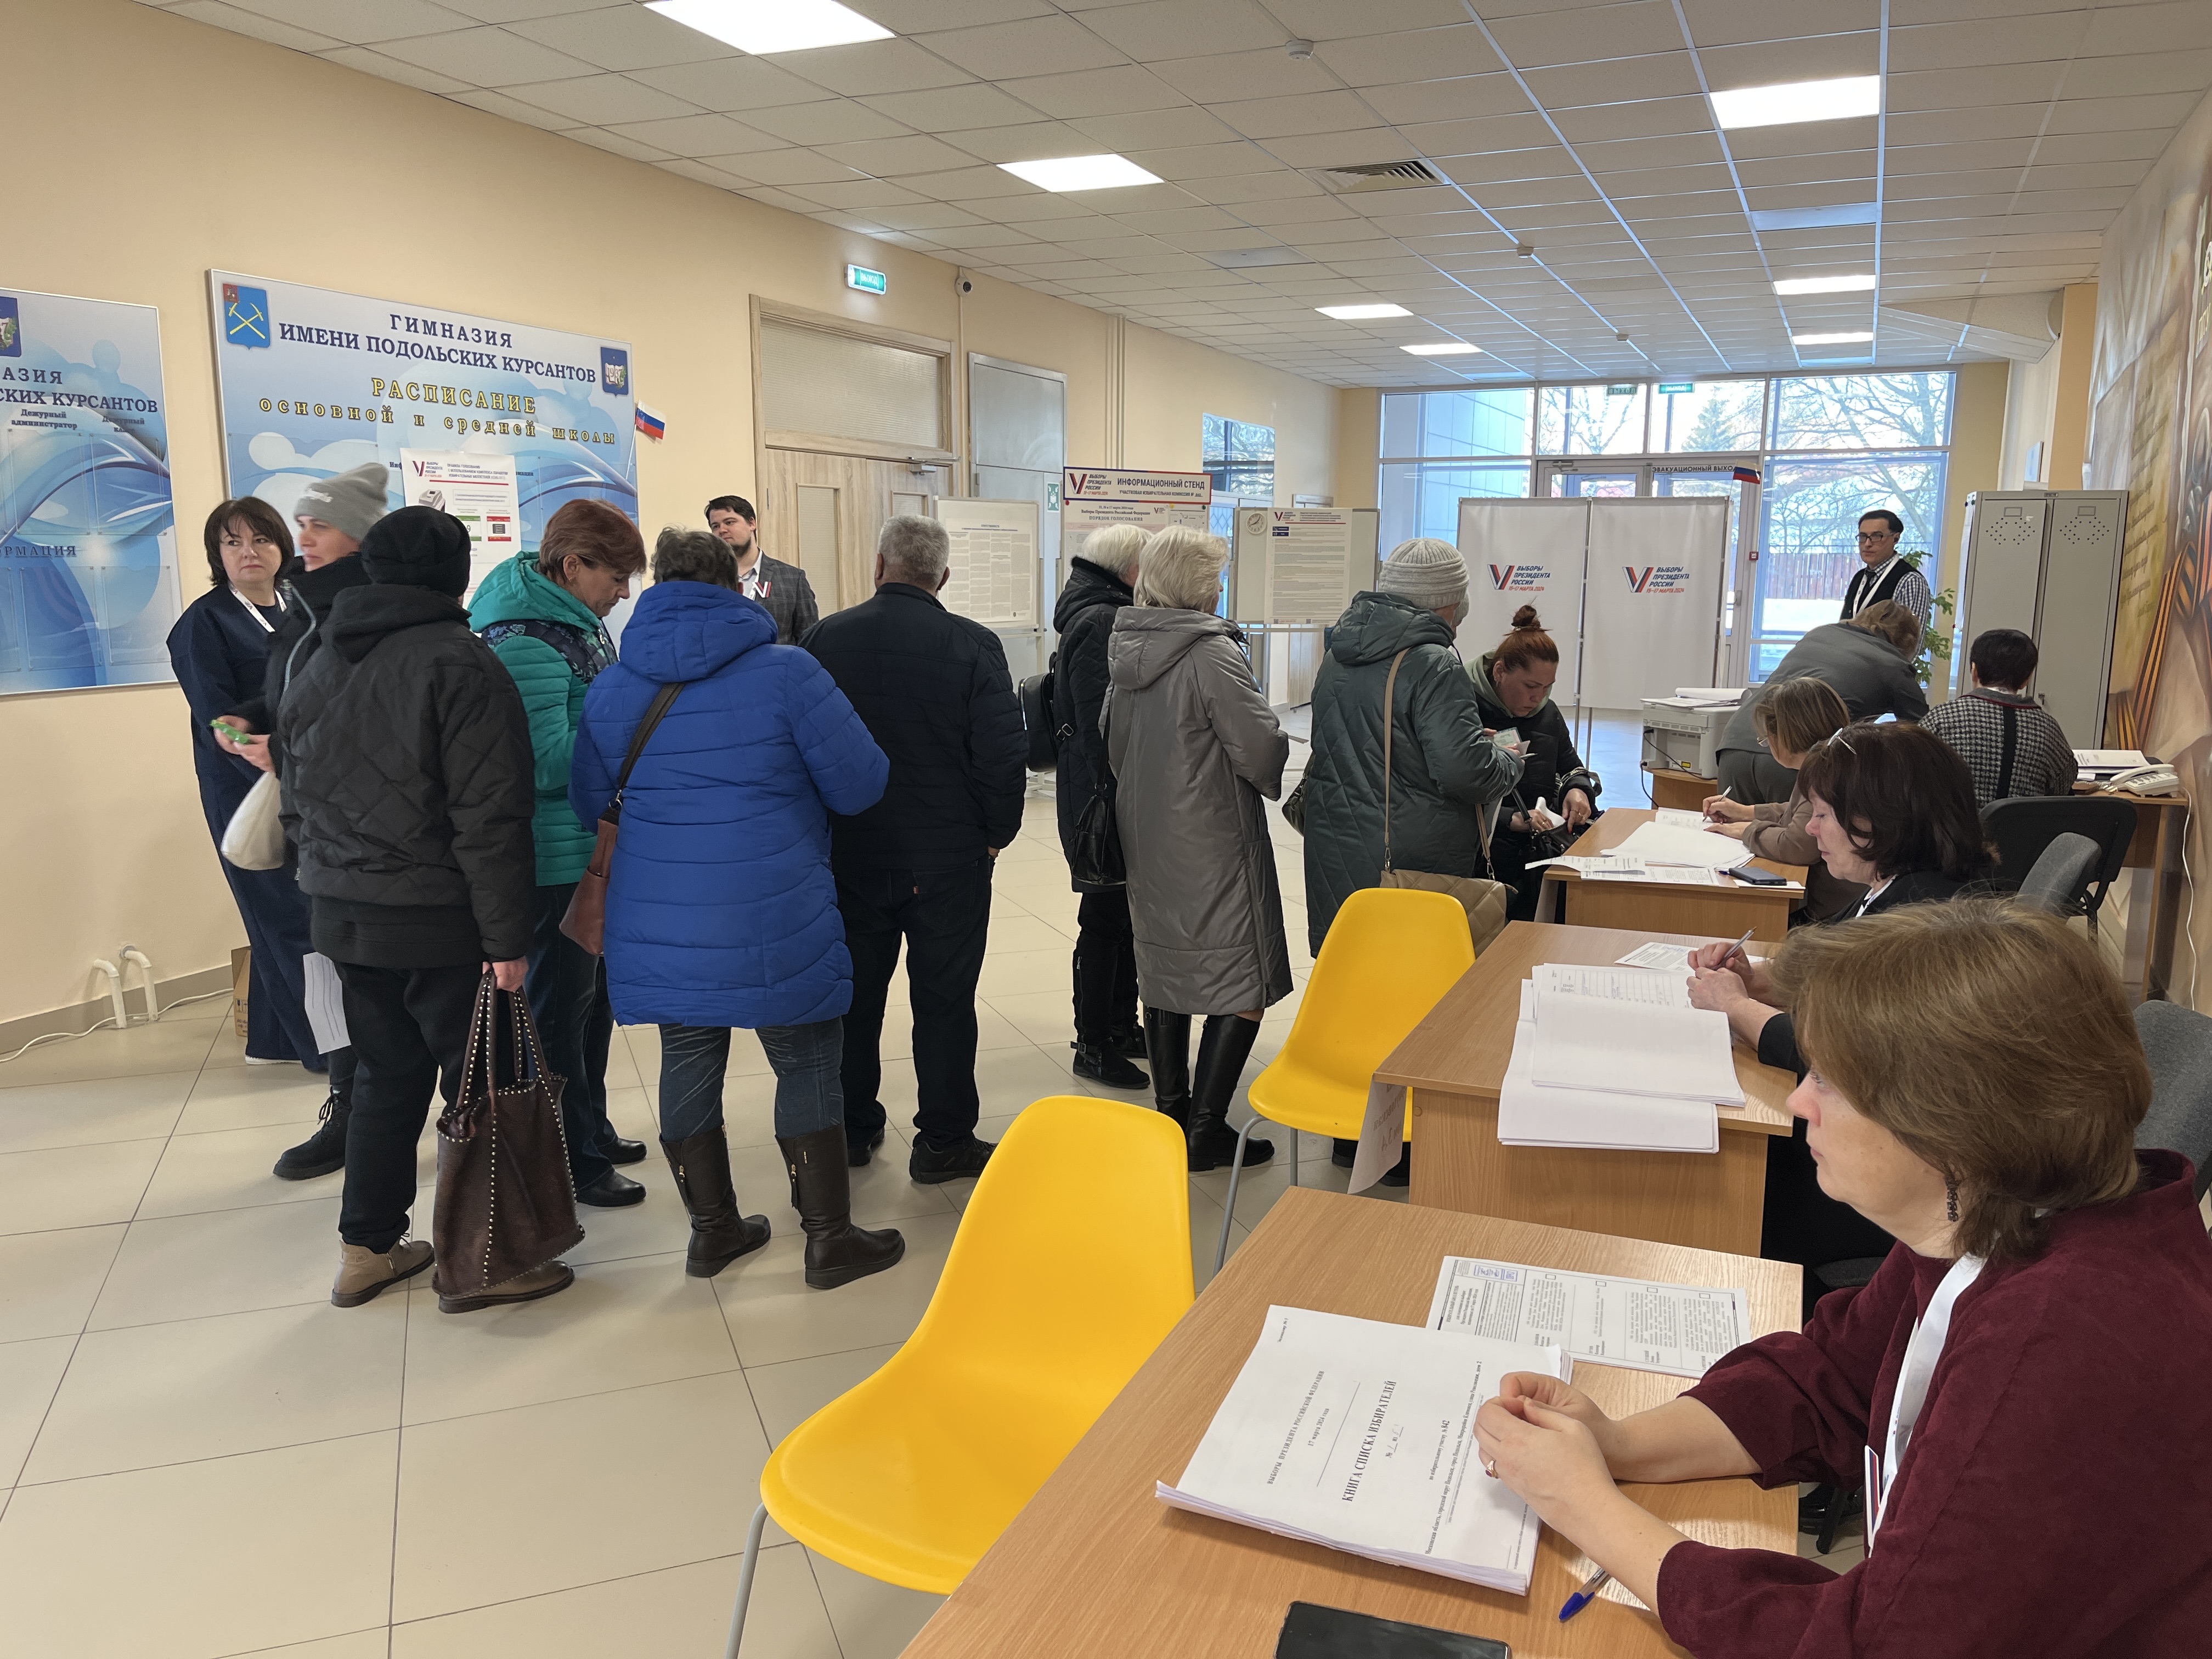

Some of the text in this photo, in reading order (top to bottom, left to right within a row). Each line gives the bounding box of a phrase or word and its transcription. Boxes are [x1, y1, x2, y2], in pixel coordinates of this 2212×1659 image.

[390, 314, 512, 348] ГИМНАЗИЯ
[279, 323, 596, 382] ИМЕНИ ПОДОЛЬСКИХ КУРСАНТОВ
[52, 392, 157, 412] КУРСАНТОВ
[371, 377, 535, 413] РАСПИСАНИЕ
[21, 409, 66, 418] Дежурный
[259, 398, 614, 444] основной и средней школы
[12, 420, 77, 430] администратор
[1117, 478, 1205, 490] ИНФОРМАЦИОННЫЙ СТЕНД
[0, 545, 76, 557] РМАЦИЯ
[1312, 1427, 1321, 1440] марта
[1441, 1420, 1449, 1429] 842
[1267, 1462, 1282, 1484] ВЫБОРЫ
[1278, 1426, 1298, 1460] ПРЕЗИДЕНТА
[1294, 1396, 1312, 1426] РОССИЙСКОЙ
[1342, 1380, 1397, 1502] КНИГА СПИСКА ИЗБИРАТЕЛЕЙ
